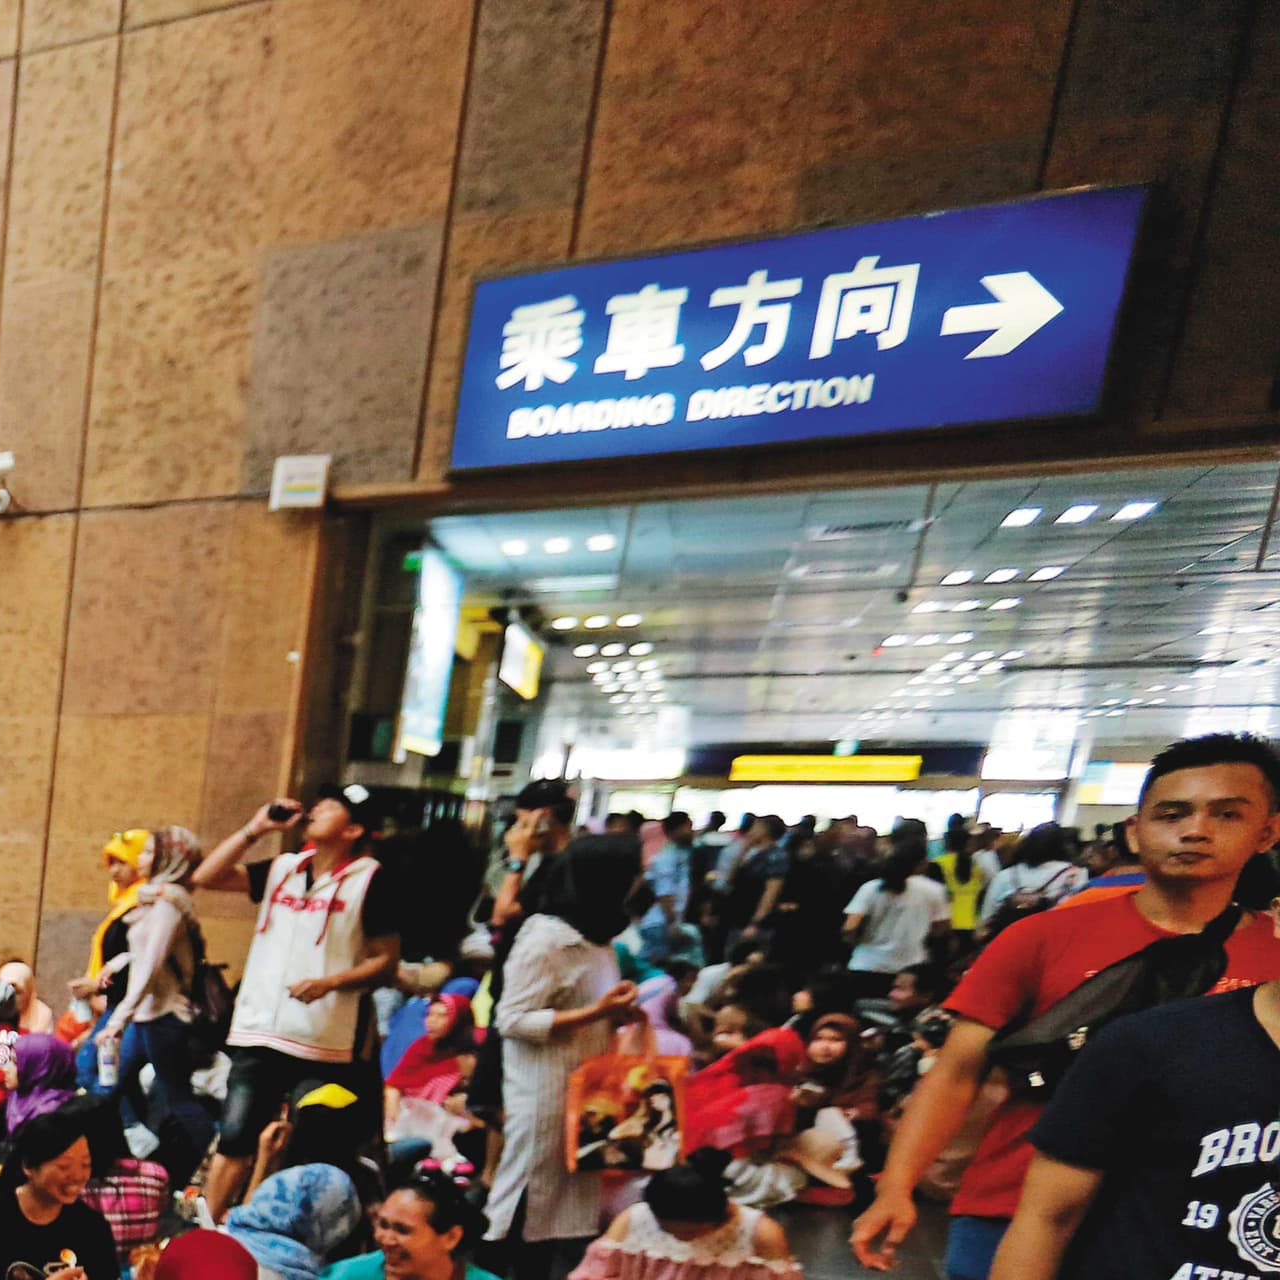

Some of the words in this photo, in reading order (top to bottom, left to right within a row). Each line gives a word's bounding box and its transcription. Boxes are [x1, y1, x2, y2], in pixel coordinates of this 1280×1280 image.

[494, 255, 921, 391] 乘車方向
[506, 391, 676, 440] BOARDING
[687, 373, 875, 422] DIRECTION
[1181, 1200, 1219, 1229] 19
